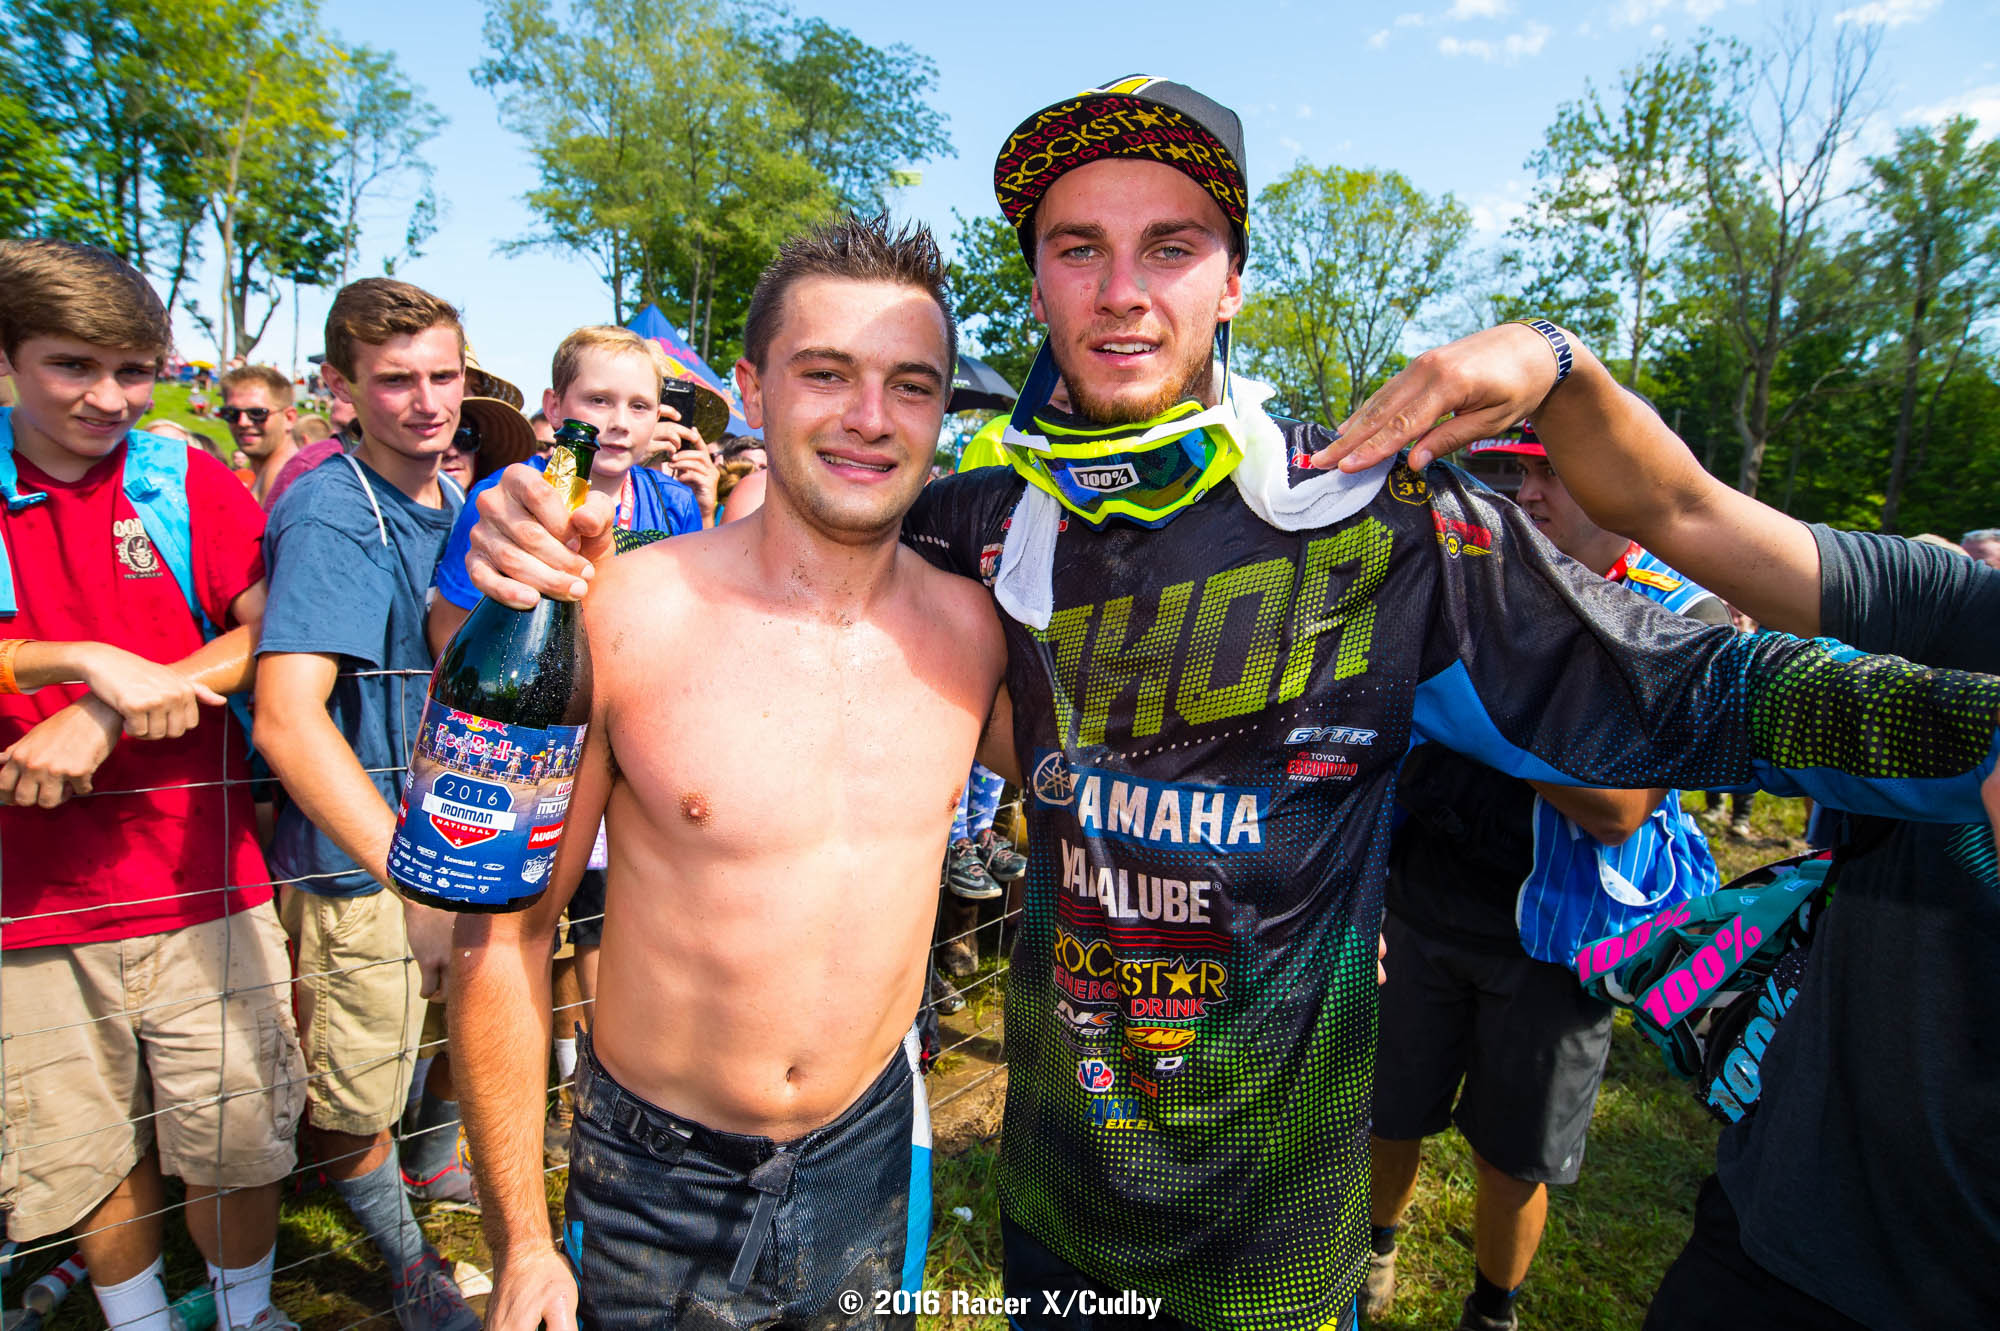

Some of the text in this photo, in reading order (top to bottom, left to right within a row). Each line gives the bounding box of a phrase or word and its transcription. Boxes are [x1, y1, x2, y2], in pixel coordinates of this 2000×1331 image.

[1122, 128, 1201, 146] DRINK
[1080, 469, 1128, 487] 100%
[1026, 516, 1394, 751] THOR
[1284, 726, 1379, 746] GYTR
[1311, 753, 1347, 763] TOYOTA
[1287, 760, 1359, 778] ESCONDIDO
[1289, 775, 1320, 783] ACTION
[444, 781, 498, 806] 2016
[440, 802, 493, 825] IRONMAN
[436, 818, 491, 836] NATIONAL
[1576, 900, 1691, 983] 100%
[1643, 915, 1762, 1028] 100%
[1055, 965, 1208, 1018] ENERG DRINK
[1125, 1029, 1197, 1046] FMF
[1105, 1119, 1161, 1132] EXCEL
